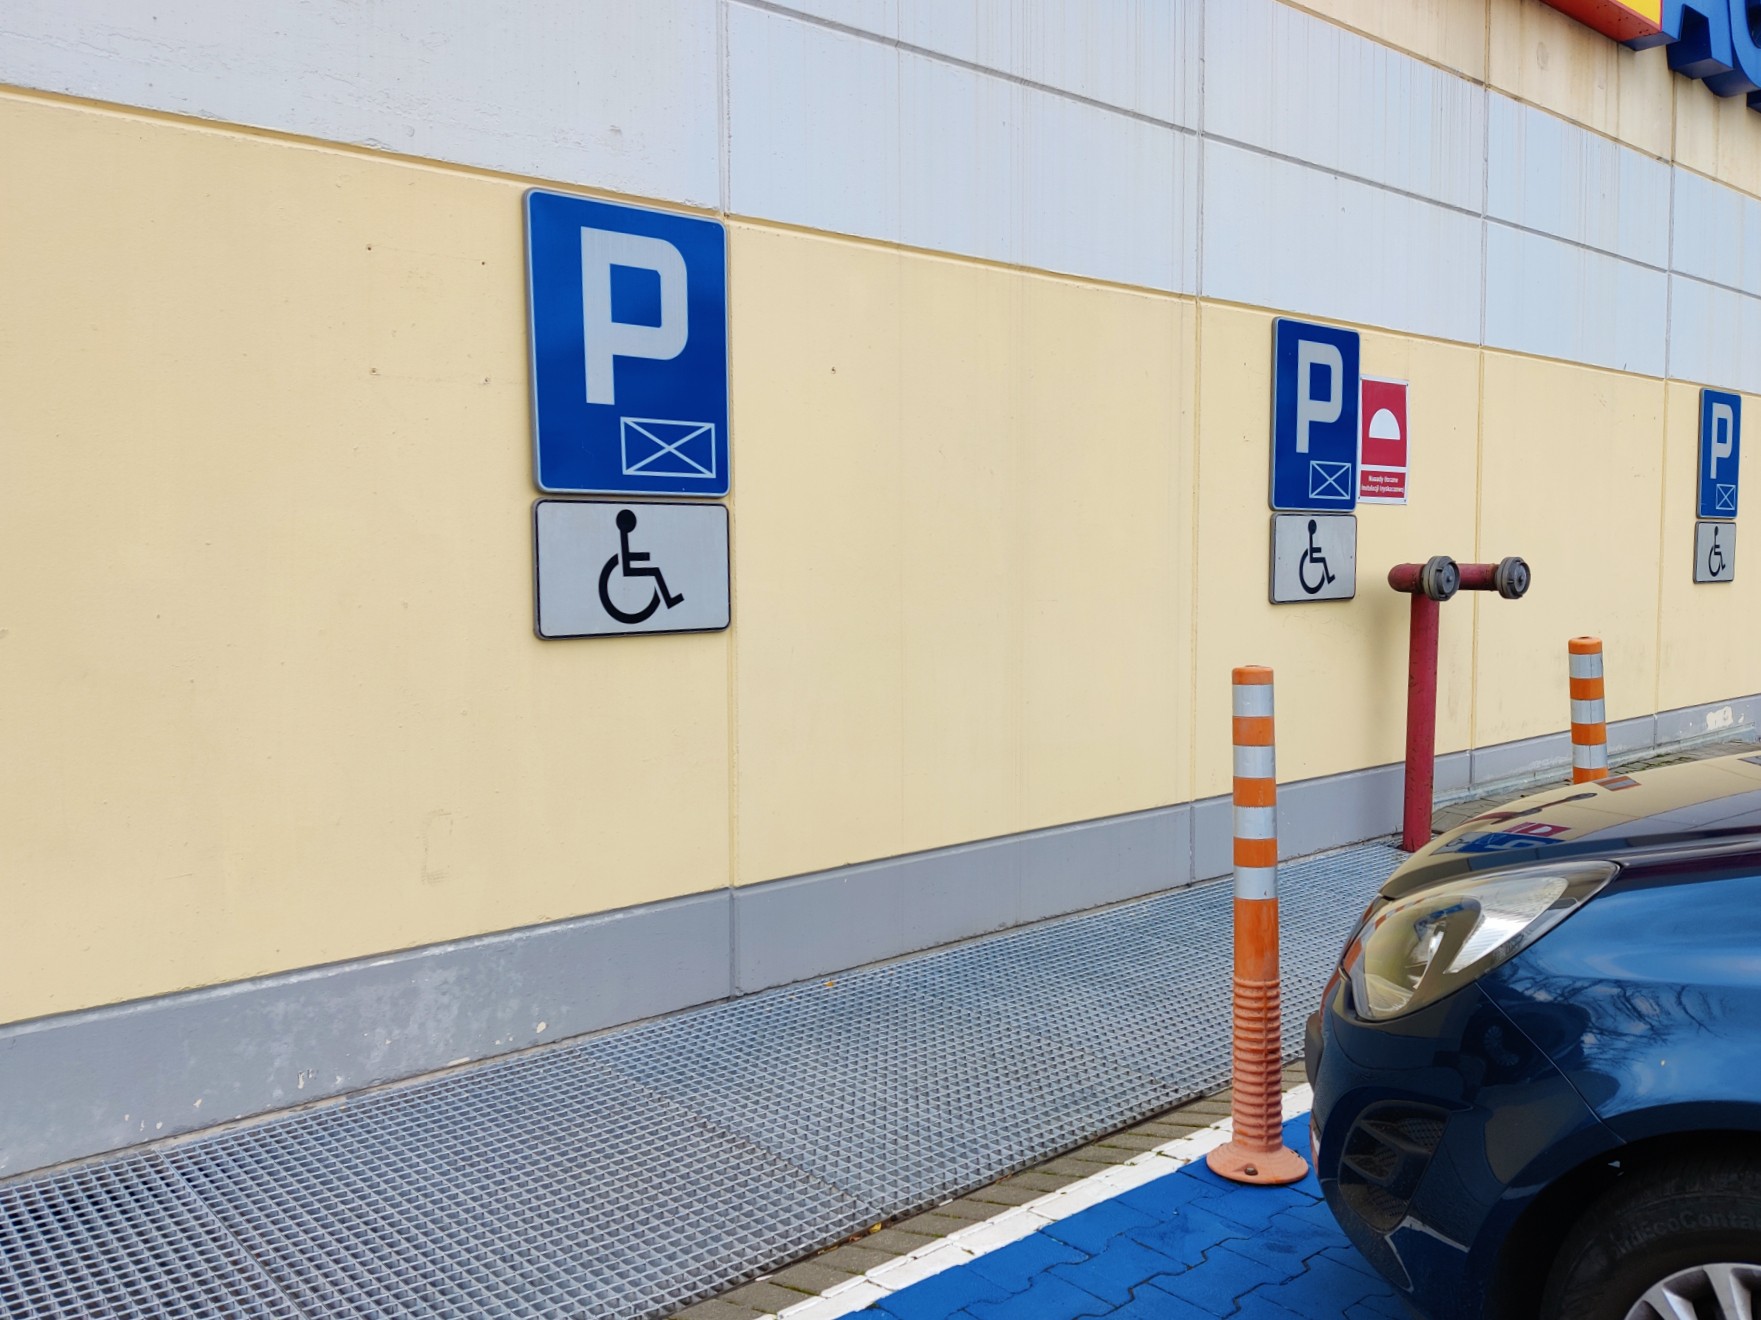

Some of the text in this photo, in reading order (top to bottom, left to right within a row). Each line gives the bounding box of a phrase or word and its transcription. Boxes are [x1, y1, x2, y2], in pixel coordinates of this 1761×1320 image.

[581, 226, 688, 405] P
[1296, 339, 1344, 453] P
[1710, 402, 1734, 479] P
